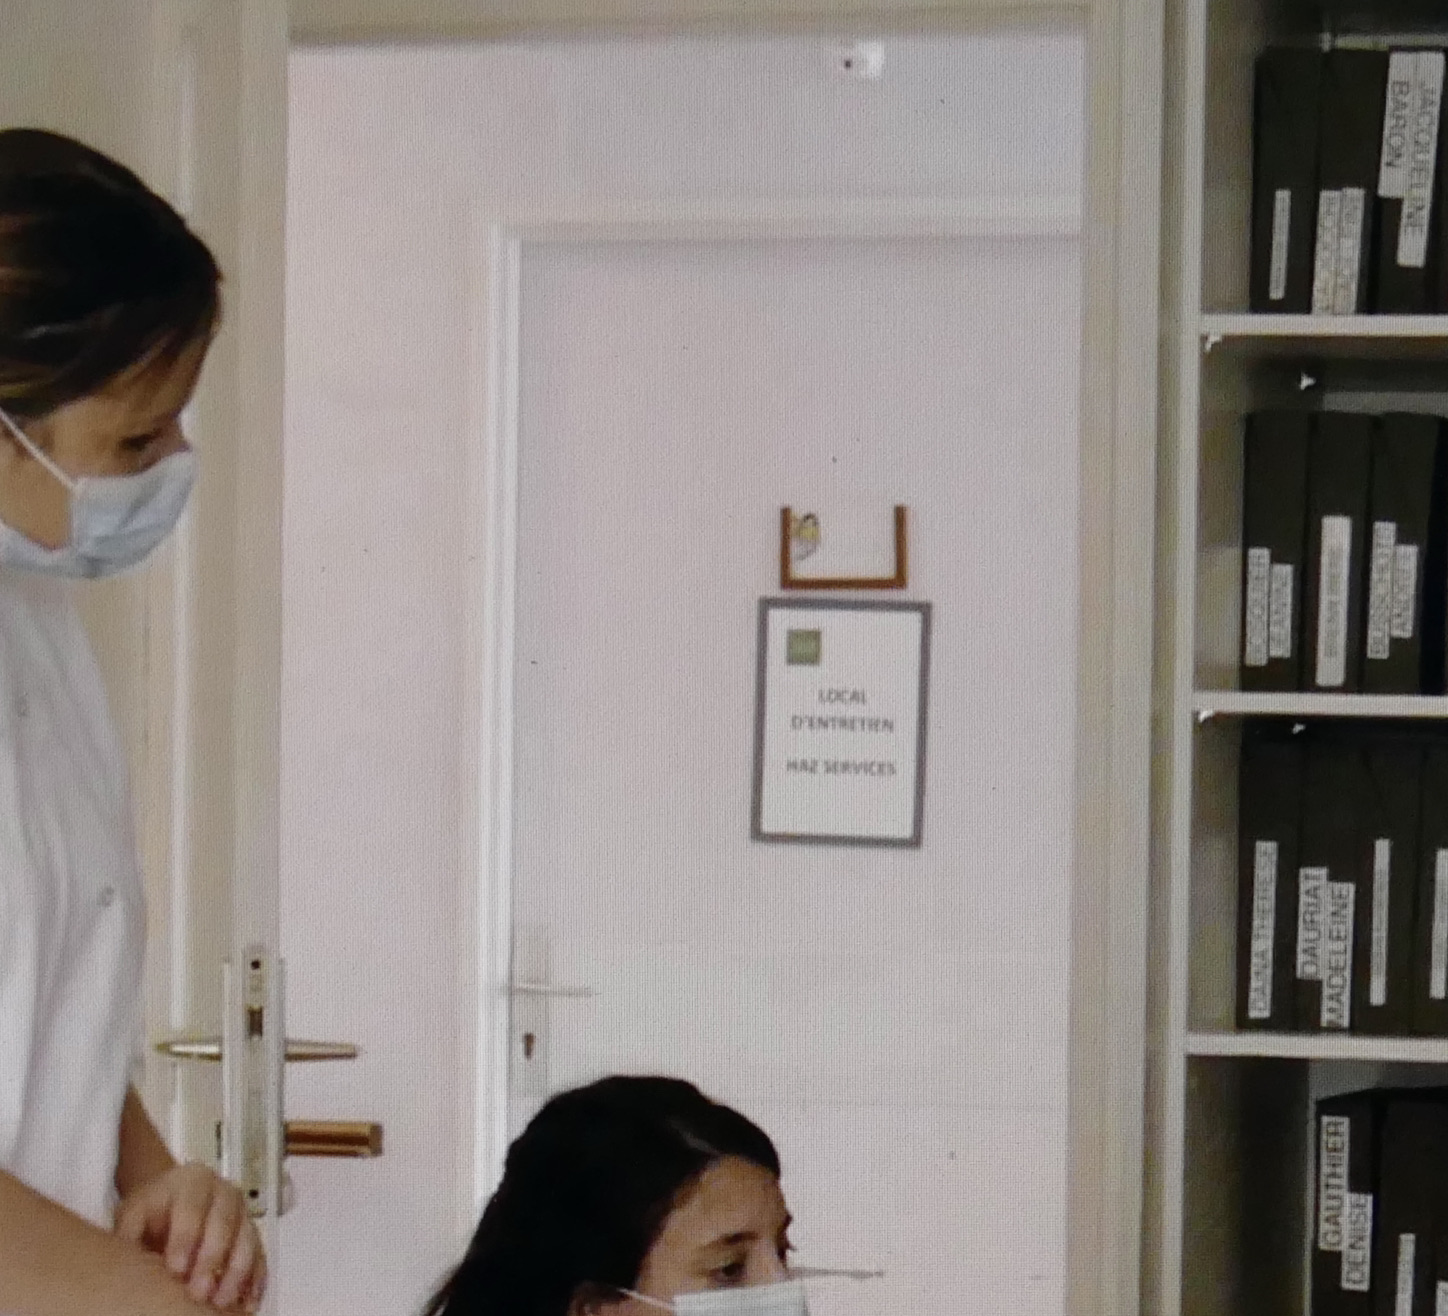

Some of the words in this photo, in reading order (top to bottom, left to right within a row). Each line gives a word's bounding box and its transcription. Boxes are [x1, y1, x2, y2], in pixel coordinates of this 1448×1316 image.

[1385, 81, 1410, 168] BARON
[1404, 87, 1437, 235] JACQUELINE
[791, 714, 895, 733] D'ENTRETIEN
[817, 688, 867, 705] LOCAL
[823, 760, 897, 777] SERVICES
[1300, 873, 1322, 978] DAURIAT
[1325, 885, 1350, 1025] MADELEINE
[1322, 1119, 1346, 1249] GAUTHIER
[1344, 1193, 1369, 1286] DENISE
